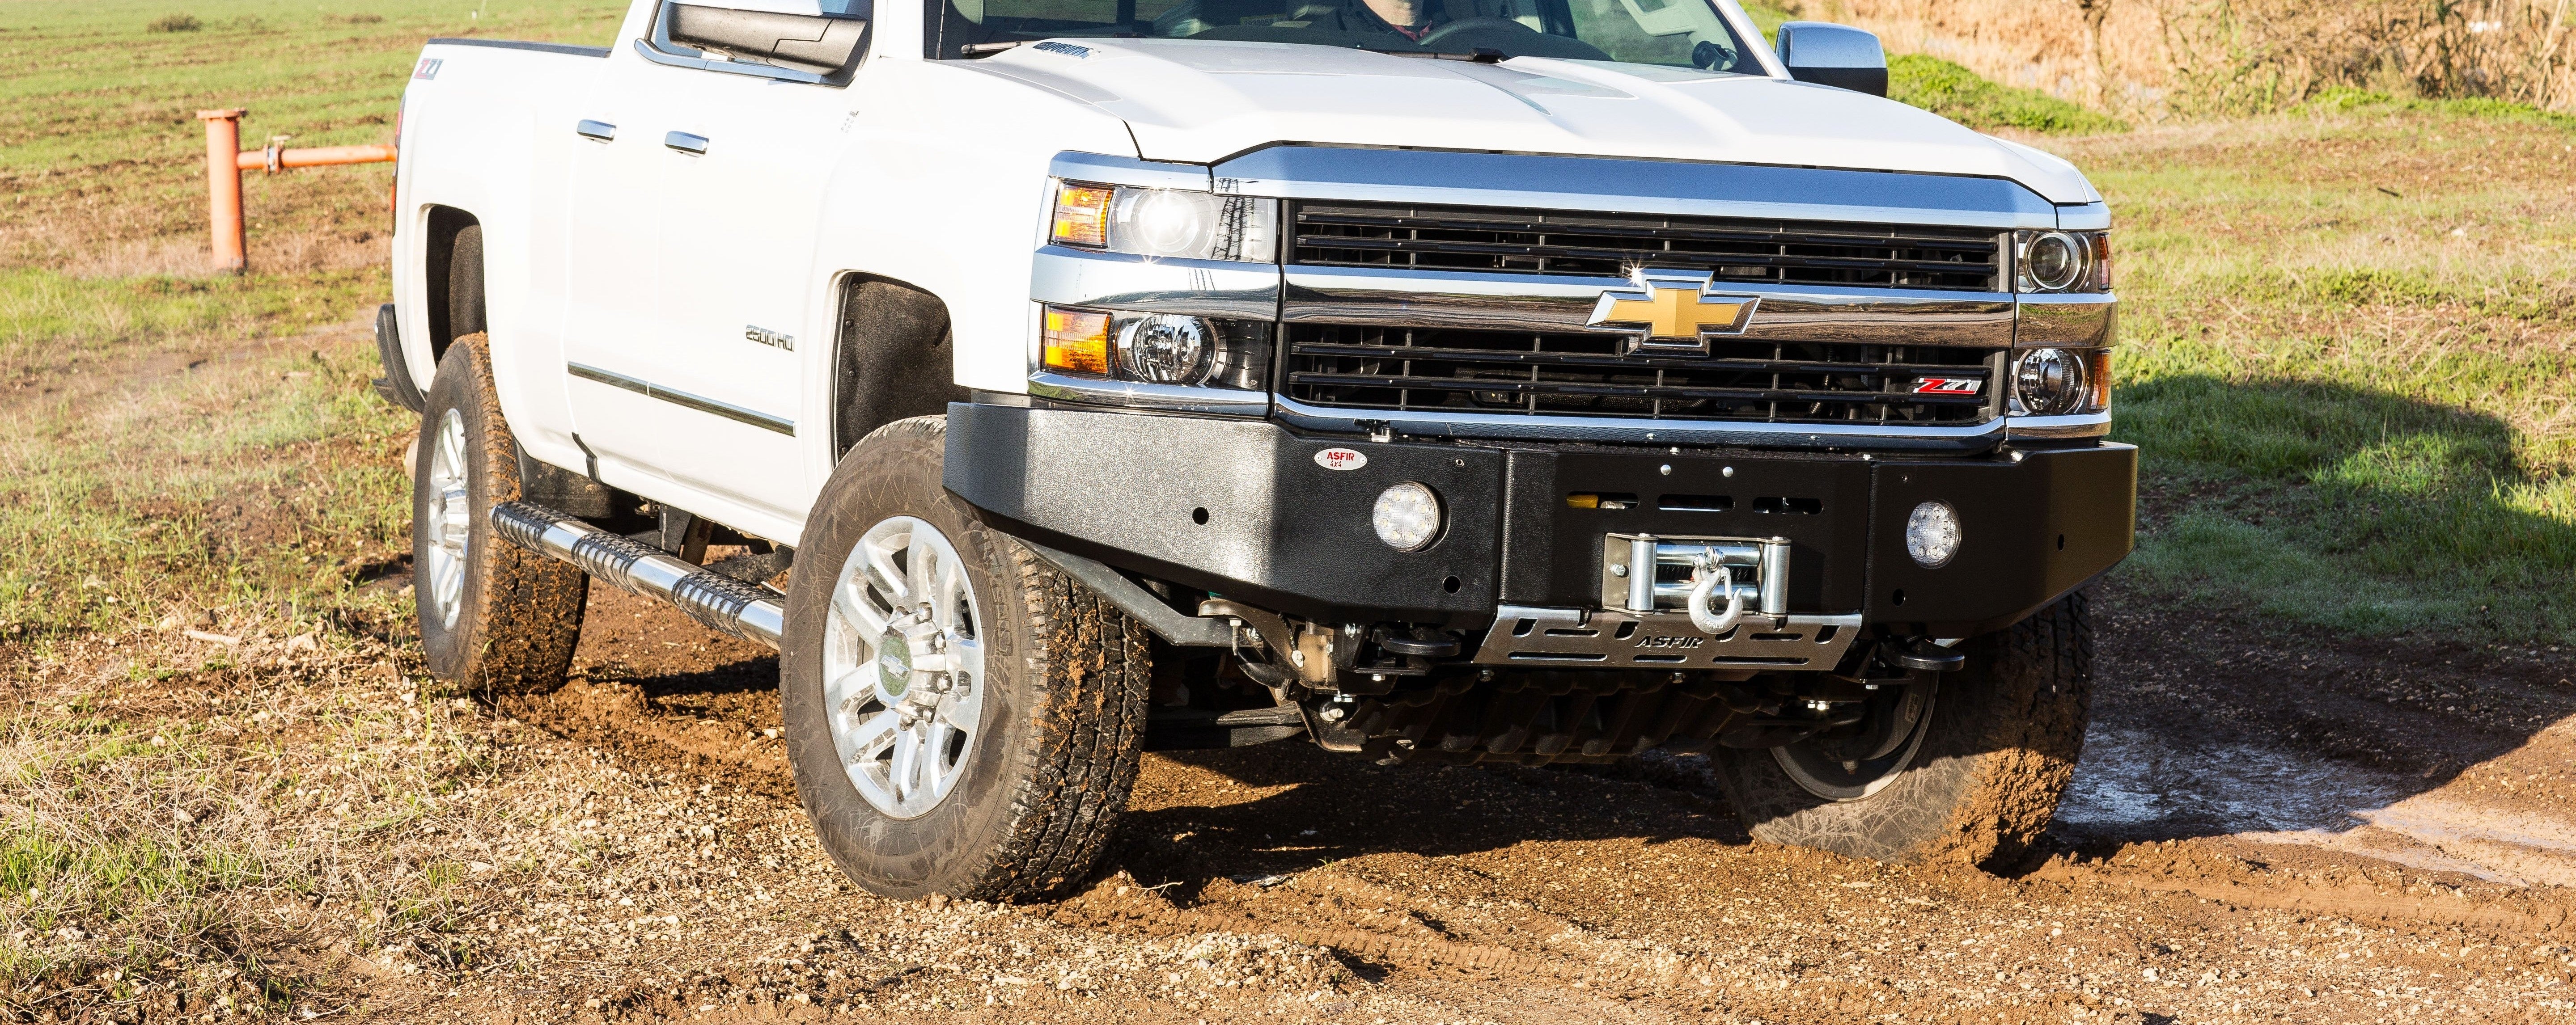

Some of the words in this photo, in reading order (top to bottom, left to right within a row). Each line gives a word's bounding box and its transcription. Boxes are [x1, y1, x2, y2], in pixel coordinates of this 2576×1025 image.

[414, 58, 444, 80] Z71
[746, 324, 776, 347] 2500
[777, 332, 795, 352] HD
[1913, 378, 1982, 394] Z71
[1327, 451, 1355, 461] ASFIR
[1634, 636, 1704, 649] ASFIR
